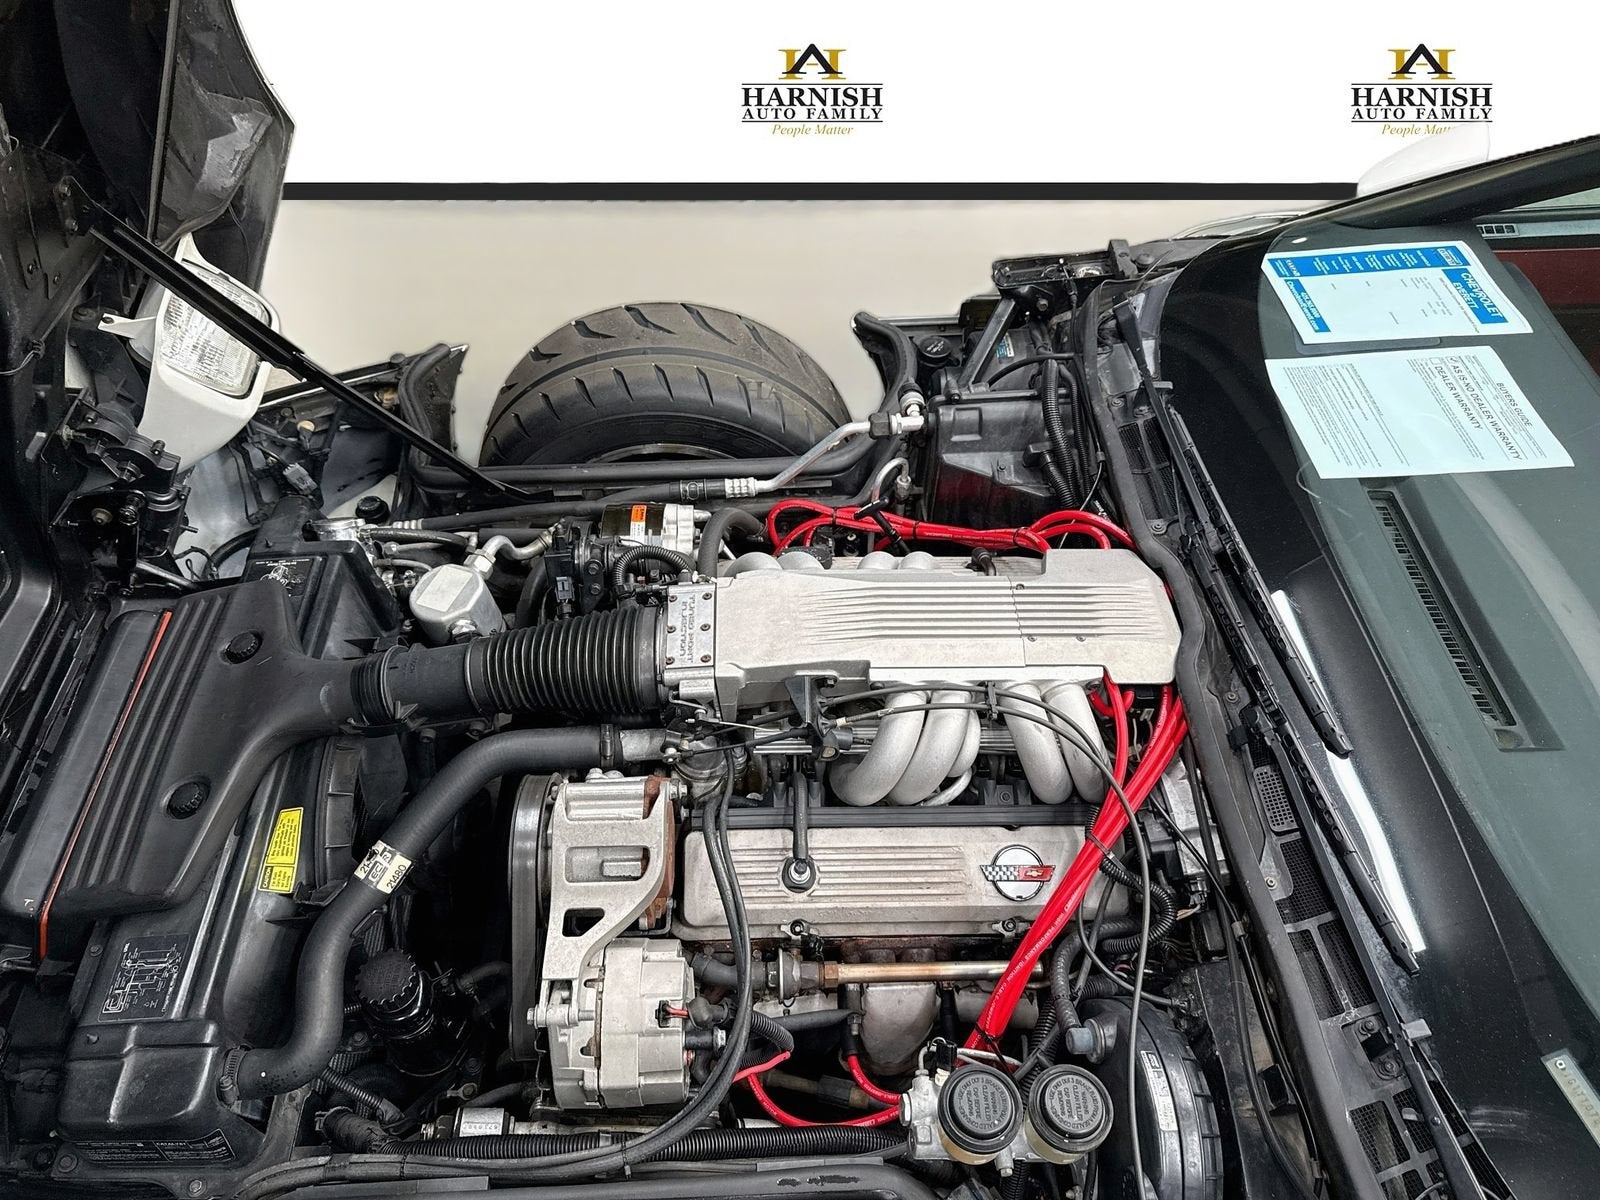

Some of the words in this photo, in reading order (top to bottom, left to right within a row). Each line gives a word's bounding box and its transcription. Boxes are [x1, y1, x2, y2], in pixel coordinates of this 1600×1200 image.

[742, 87, 883, 107] HARNISH
[1351, 87, 1493, 107] HARNISH
[743, 108, 796, 120] AUTO
[807, 108, 883, 120] FAMILY
[1352, 108, 1405, 120] AUTO
[1416, 108, 1492, 120] FAMILY
[772, 124, 812, 138] People
[814, 124, 854, 135] Matter
[1382, 124, 1421, 138] People
[1424, 124, 1452, 135] Matt
[1451, 282, 1478, 308] EVERETT
[1459, 272, 1502, 317] CHEVROLET
[1433, 366, 1457, 391] DEALER
[1451, 392, 1483, 429] WARRANTY
[1495, 382, 1519, 406] BUYERS
[1512, 407, 1533, 426] GUIDE
[1450, 365, 1462, 373] AS
[1469, 393, 1494, 419] DEALER
[1488, 420, 1522, 459] WARRANTY
[262, 867, 271, 887] CAUTION
[386, 864, 407, 889] 21480
[1025, 924, 1055, 961] PERFORMANCE
[1006, 960, 1025, 983] IGNITION
[966, 1090, 974, 1117] REMOVING
[990, 1091, 998, 1115] WARNING
[1057, 1090, 1066, 1117] REMOVING
[1072, 1084, 1080, 1102] CLEAN
[1081, 1091, 1089, 1115] WARNING
[984, 1103, 992, 1121] FILLER
[1065, 1099, 1073, 1119] BEFORE
[1075, 1103, 1083, 1121] FILLER
